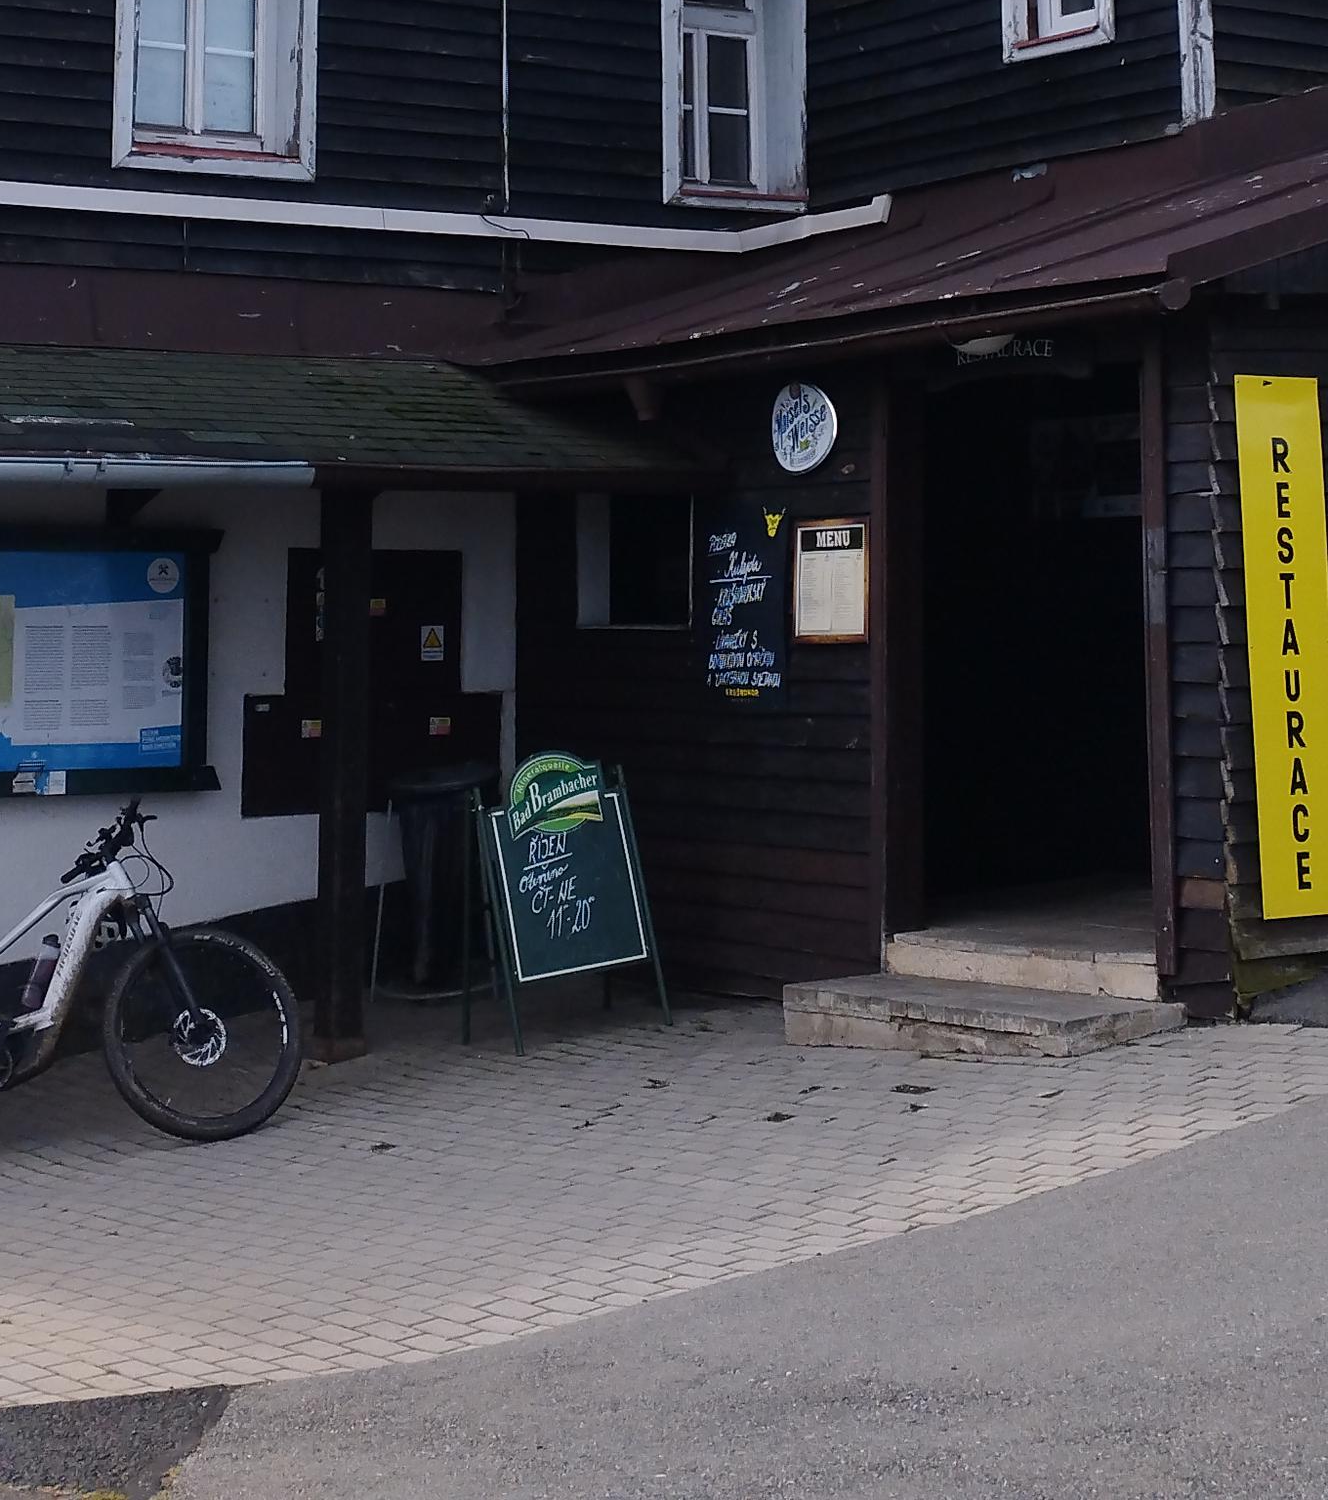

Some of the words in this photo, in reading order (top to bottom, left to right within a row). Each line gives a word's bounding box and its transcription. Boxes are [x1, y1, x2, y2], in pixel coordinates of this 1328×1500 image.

[815, 530, 851, 548] MENU
[1271, 437, 1312, 891] RESTAURACE
[512, 801, 531, 832] Bad
[528, 773, 598, 814] Brambacher
